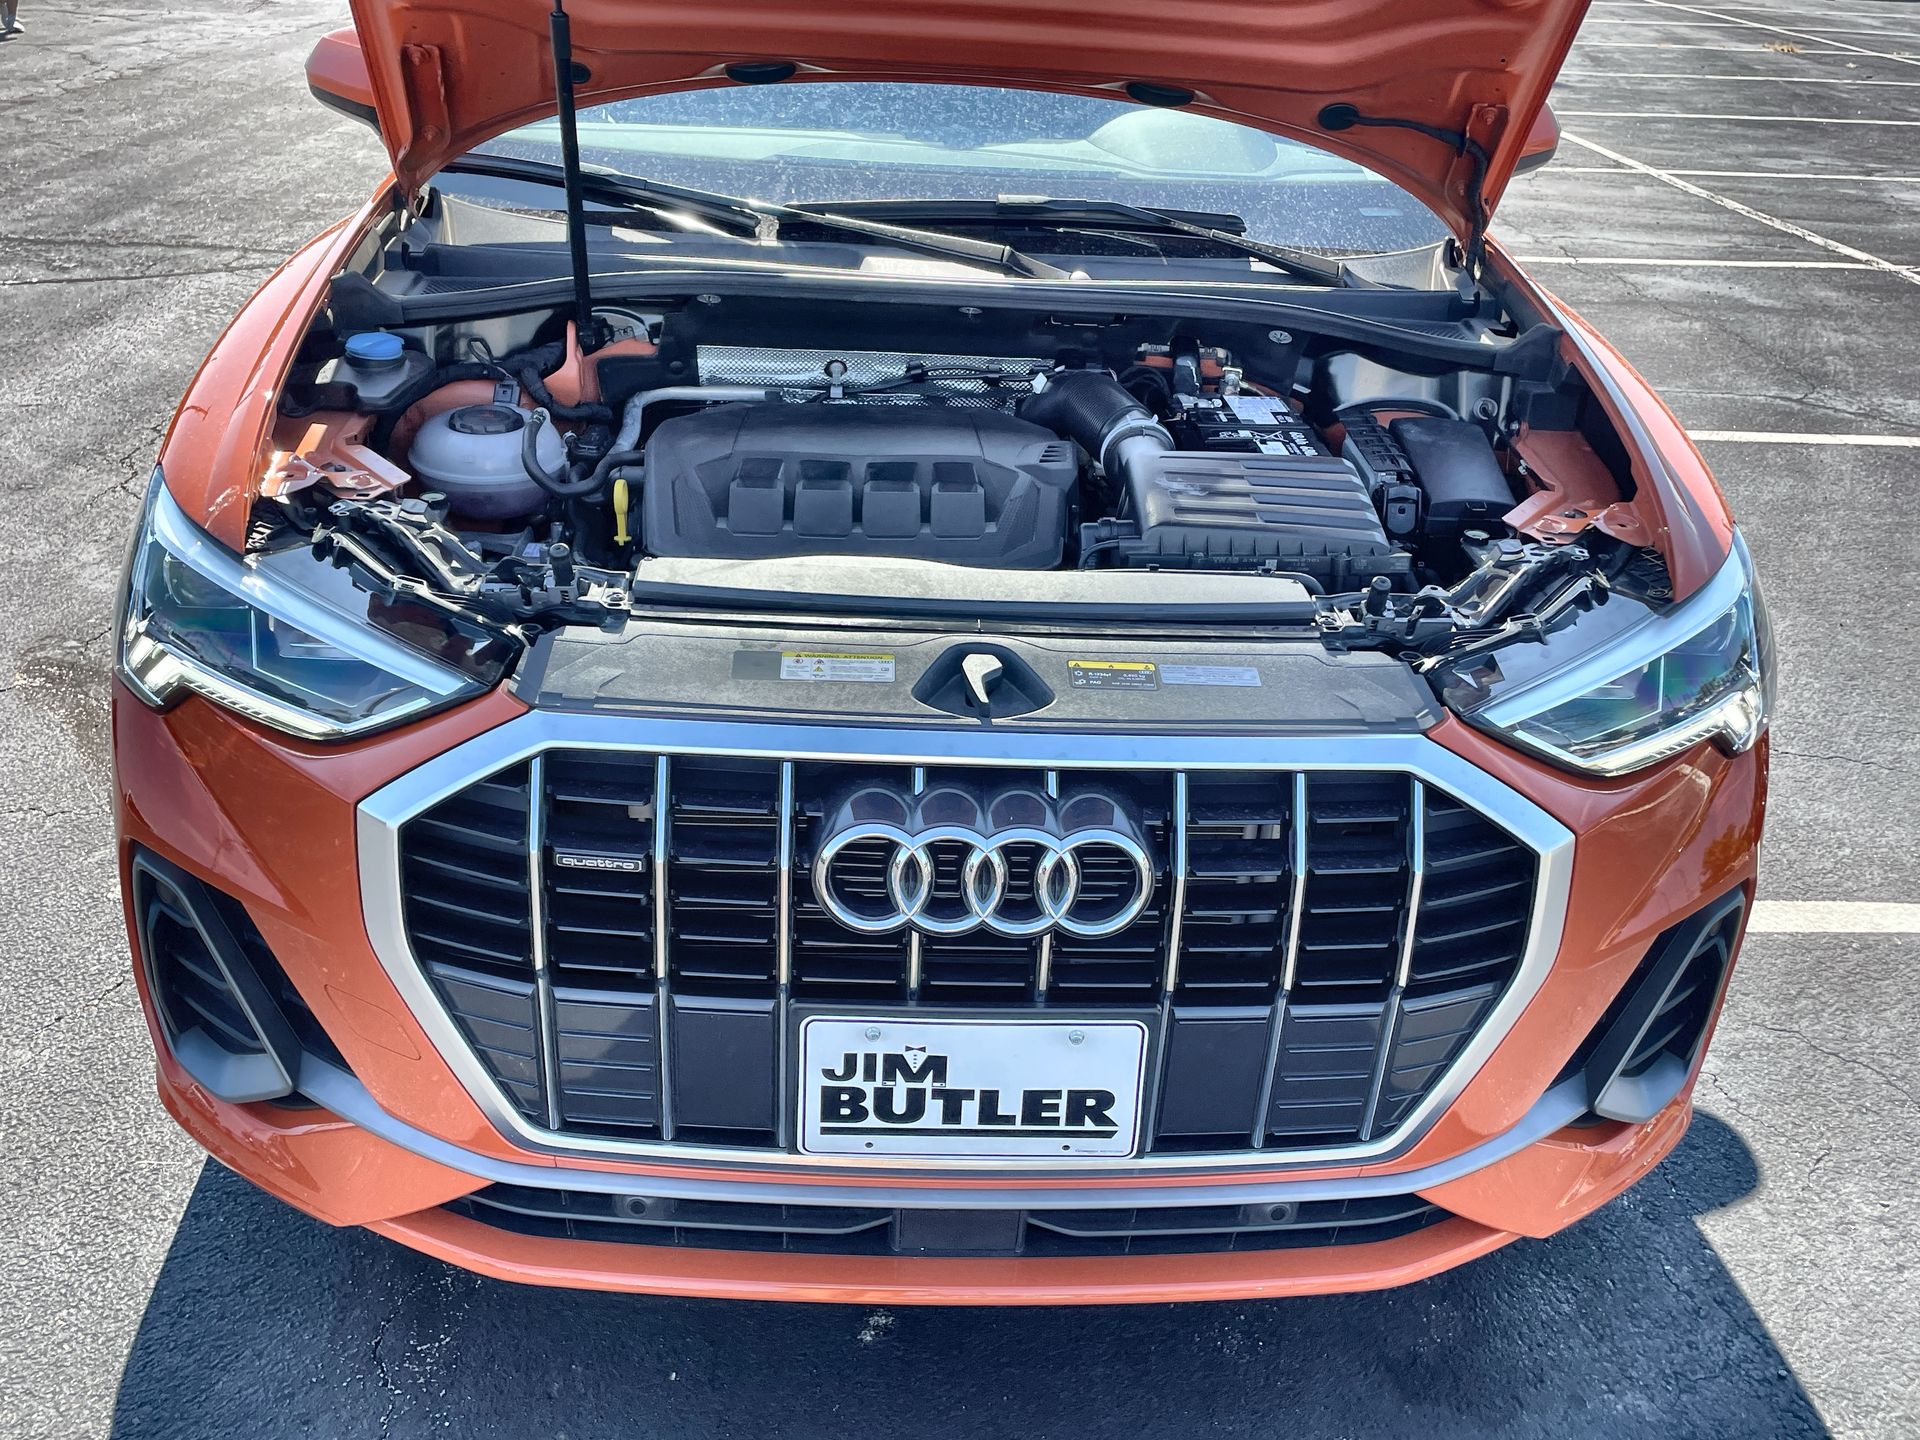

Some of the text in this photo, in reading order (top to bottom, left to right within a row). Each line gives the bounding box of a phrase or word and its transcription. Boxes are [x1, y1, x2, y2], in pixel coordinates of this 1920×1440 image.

[562, 857, 635, 869] quattro
[821, 1052, 948, 1087] JIM
[820, 1085, 1120, 1127] BUTLER
